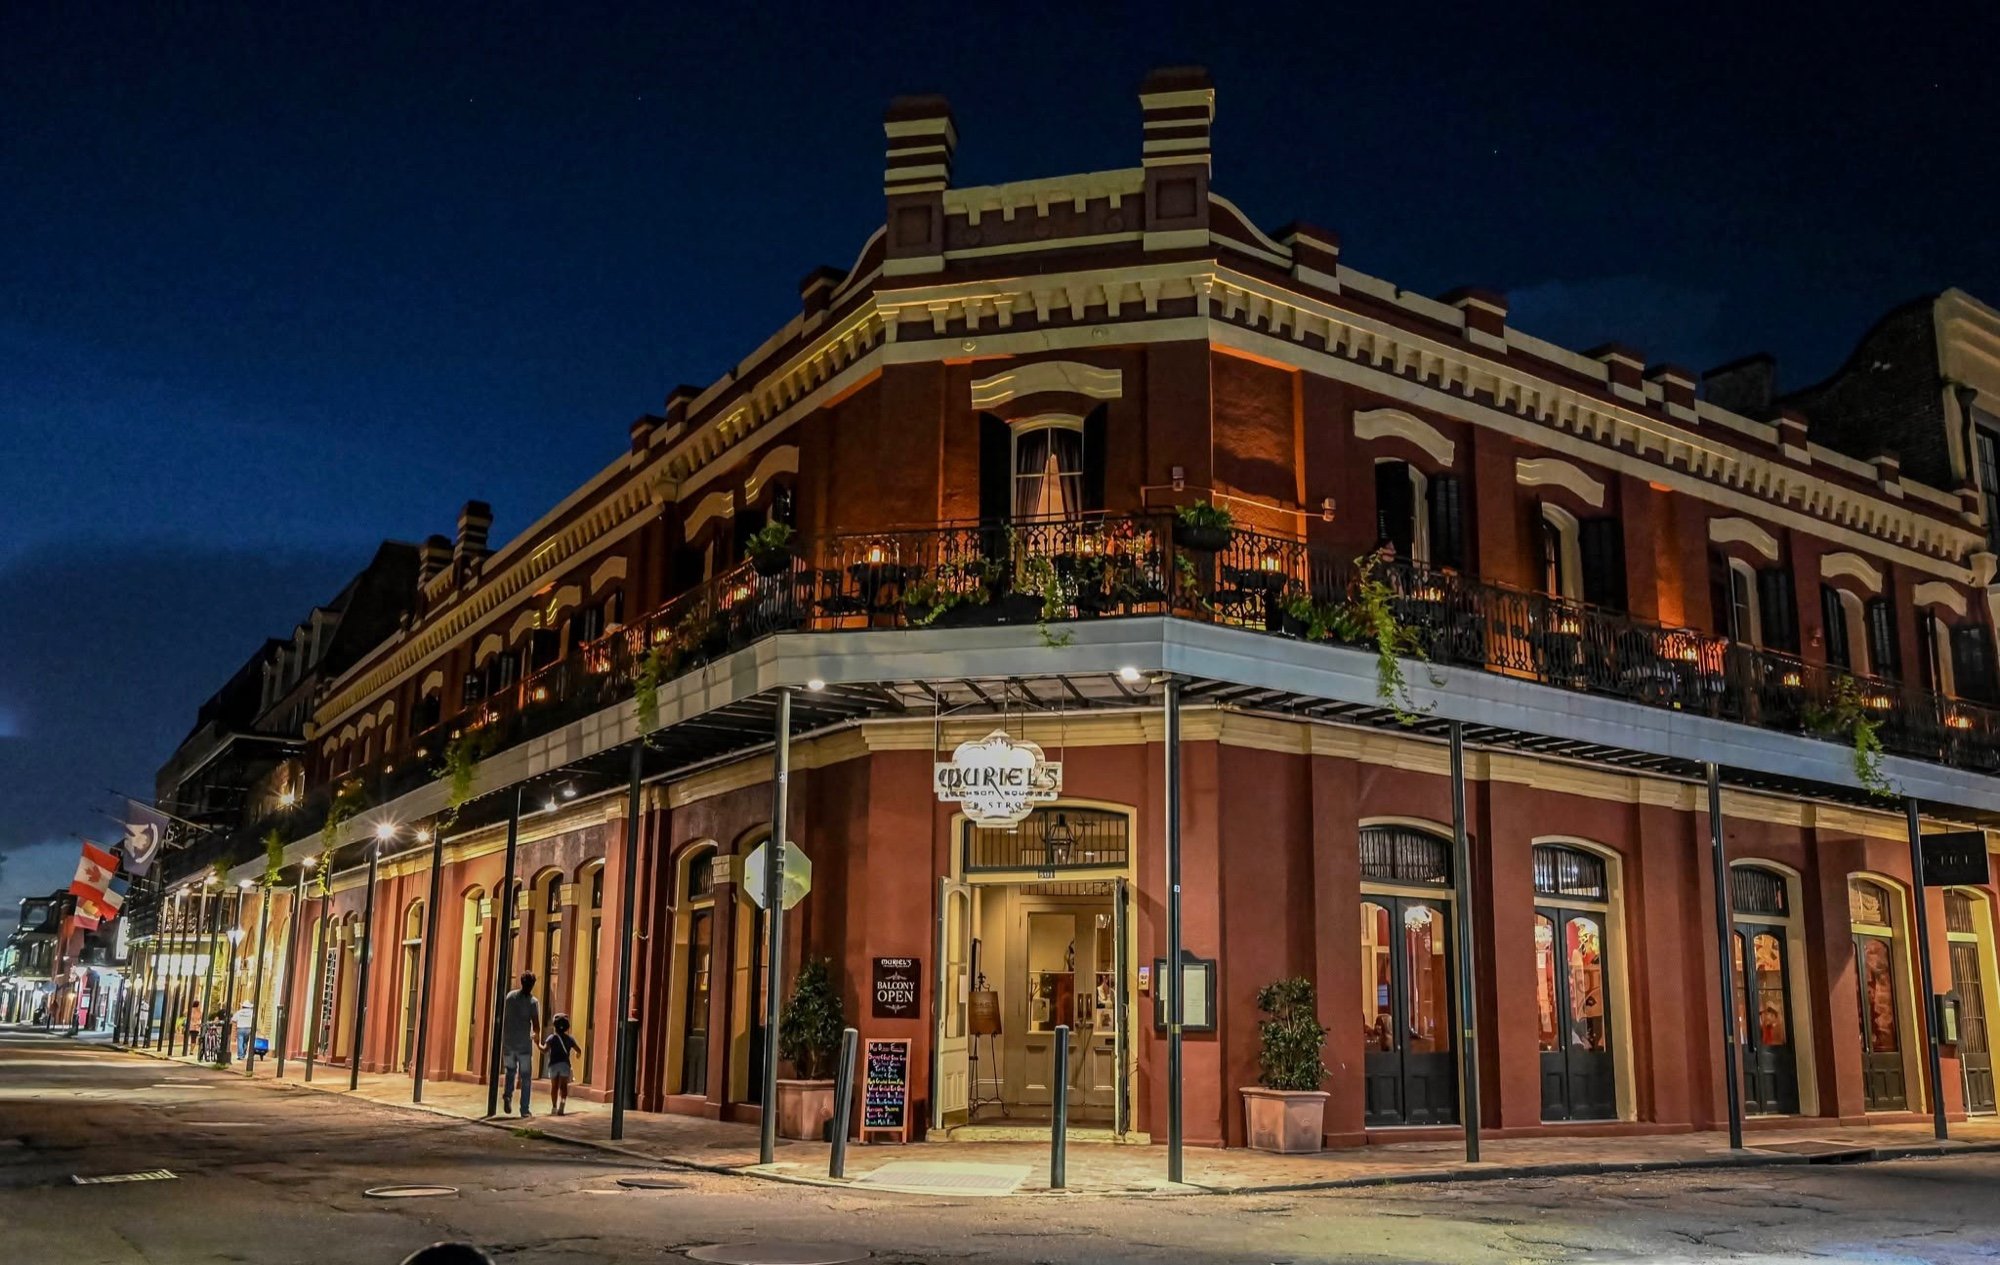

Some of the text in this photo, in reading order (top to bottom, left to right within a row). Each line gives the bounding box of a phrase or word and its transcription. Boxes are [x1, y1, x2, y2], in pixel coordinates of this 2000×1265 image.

[938, 767, 1059, 793] MURIEL'S
[973, 801, 1022, 811] BSTRO
[877, 981, 915, 990] BALCONY
[877, 990, 914, 1003] OPEN
